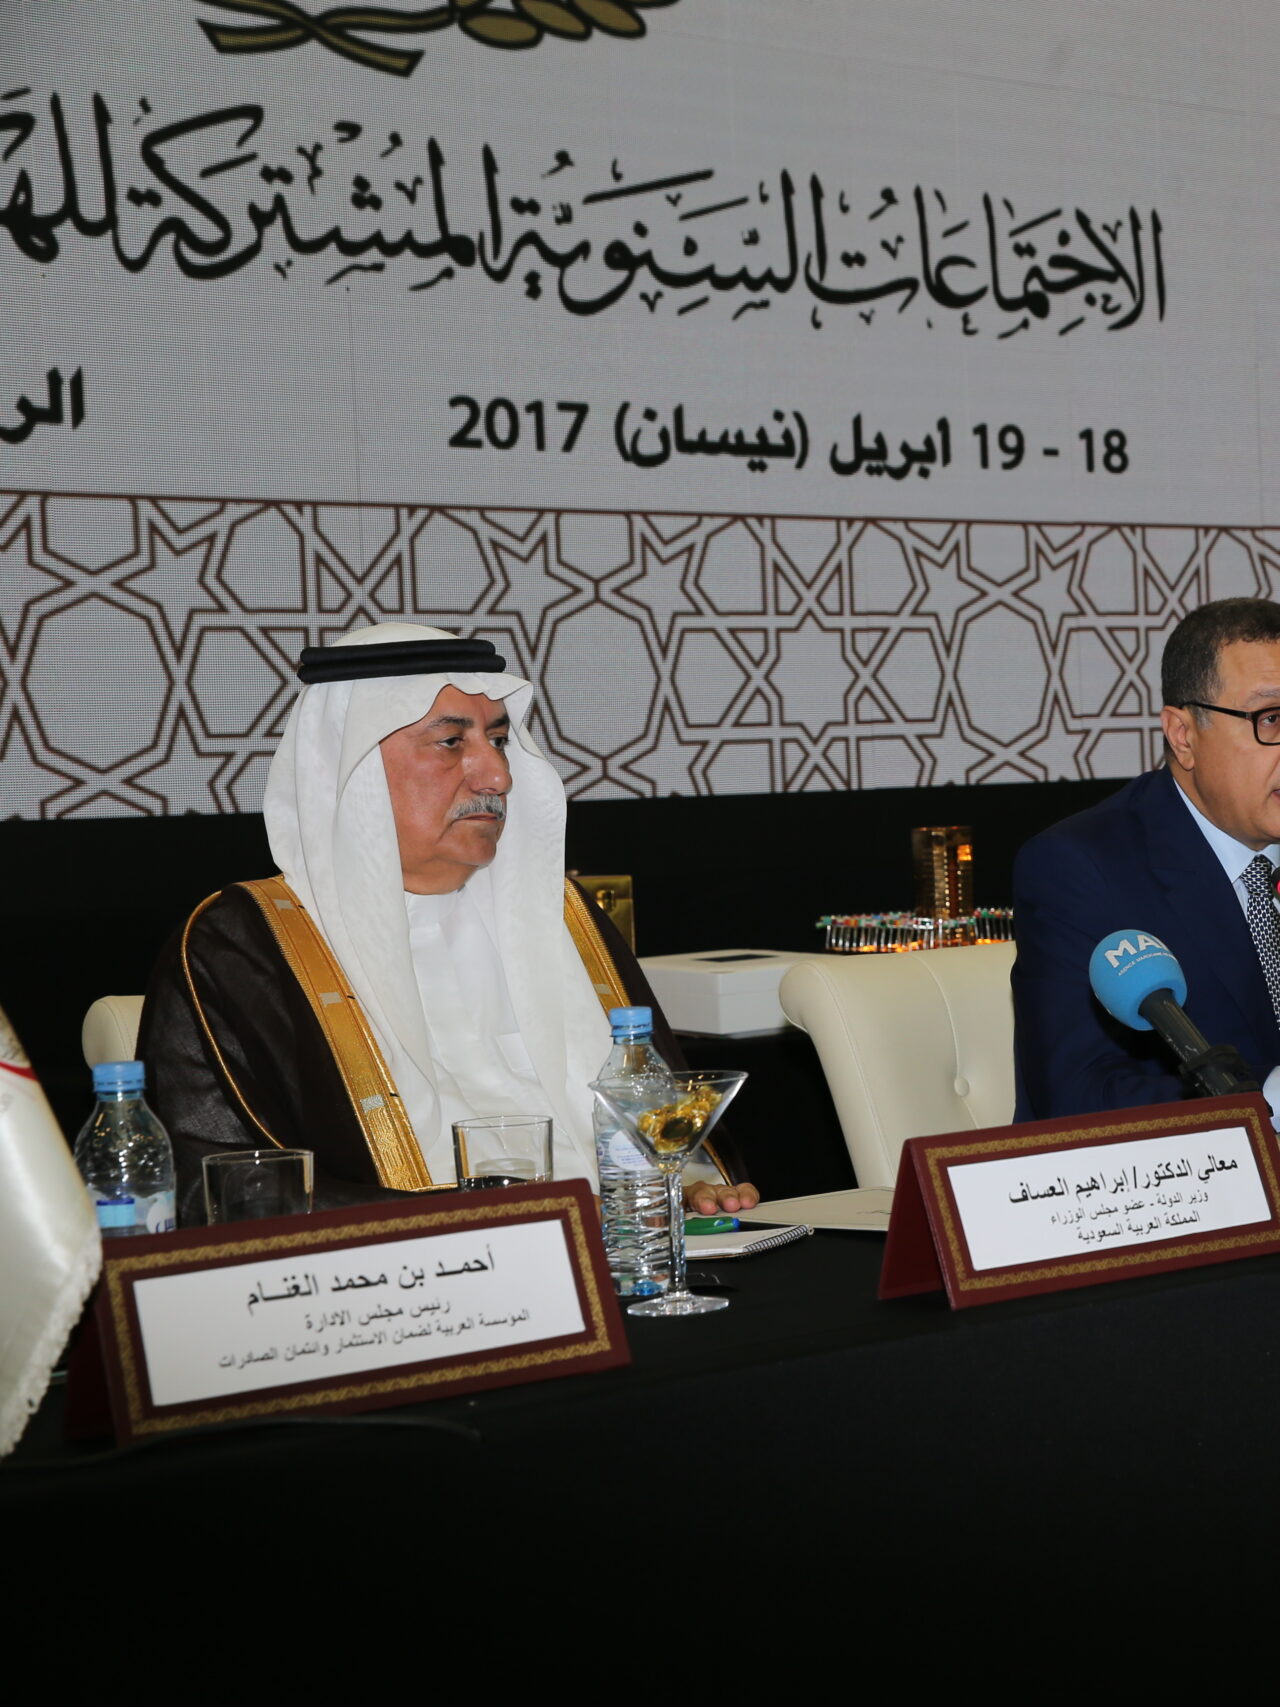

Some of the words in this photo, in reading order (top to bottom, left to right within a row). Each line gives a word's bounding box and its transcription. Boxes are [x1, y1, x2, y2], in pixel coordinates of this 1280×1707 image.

[0, 366, 85, 445] الر
[448, 395, 591, 454] 2017
[613, 401, 810, 470] (نيسان)
[829, 412, 952, 481] ابريل
[971, 422, 1025, 471] 19
[1078, 427, 1130, 475] 18
[1104, 934, 1170, 968] MA
[1197, 1154, 1239, 1185] معالي
[1008, 1175, 1070, 1204] العساف
[1156, 1191, 1184, 1208] الدولة
[1188, 1189, 1209, 1205] وزير
[1050, 1207, 1086, 1225] الوزراء
[1089, 1203, 1119, 1221] مجلس
[1122, 1199, 1145, 1215] عضو
[1164, 1209, 1201, 1227] المملكة
[1077, 1221, 1124, 1245] السعودية
[1127, 1216, 1162, 1236] العربية
[331, 1272, 389, 1293] محمد
[398, 1264, 425, 1290] بن
[357, 1303, 404, 1327] مجلس
[409, 1297, 451, 1319] رئيس
[435, 1316, 475, 1338] العربية
